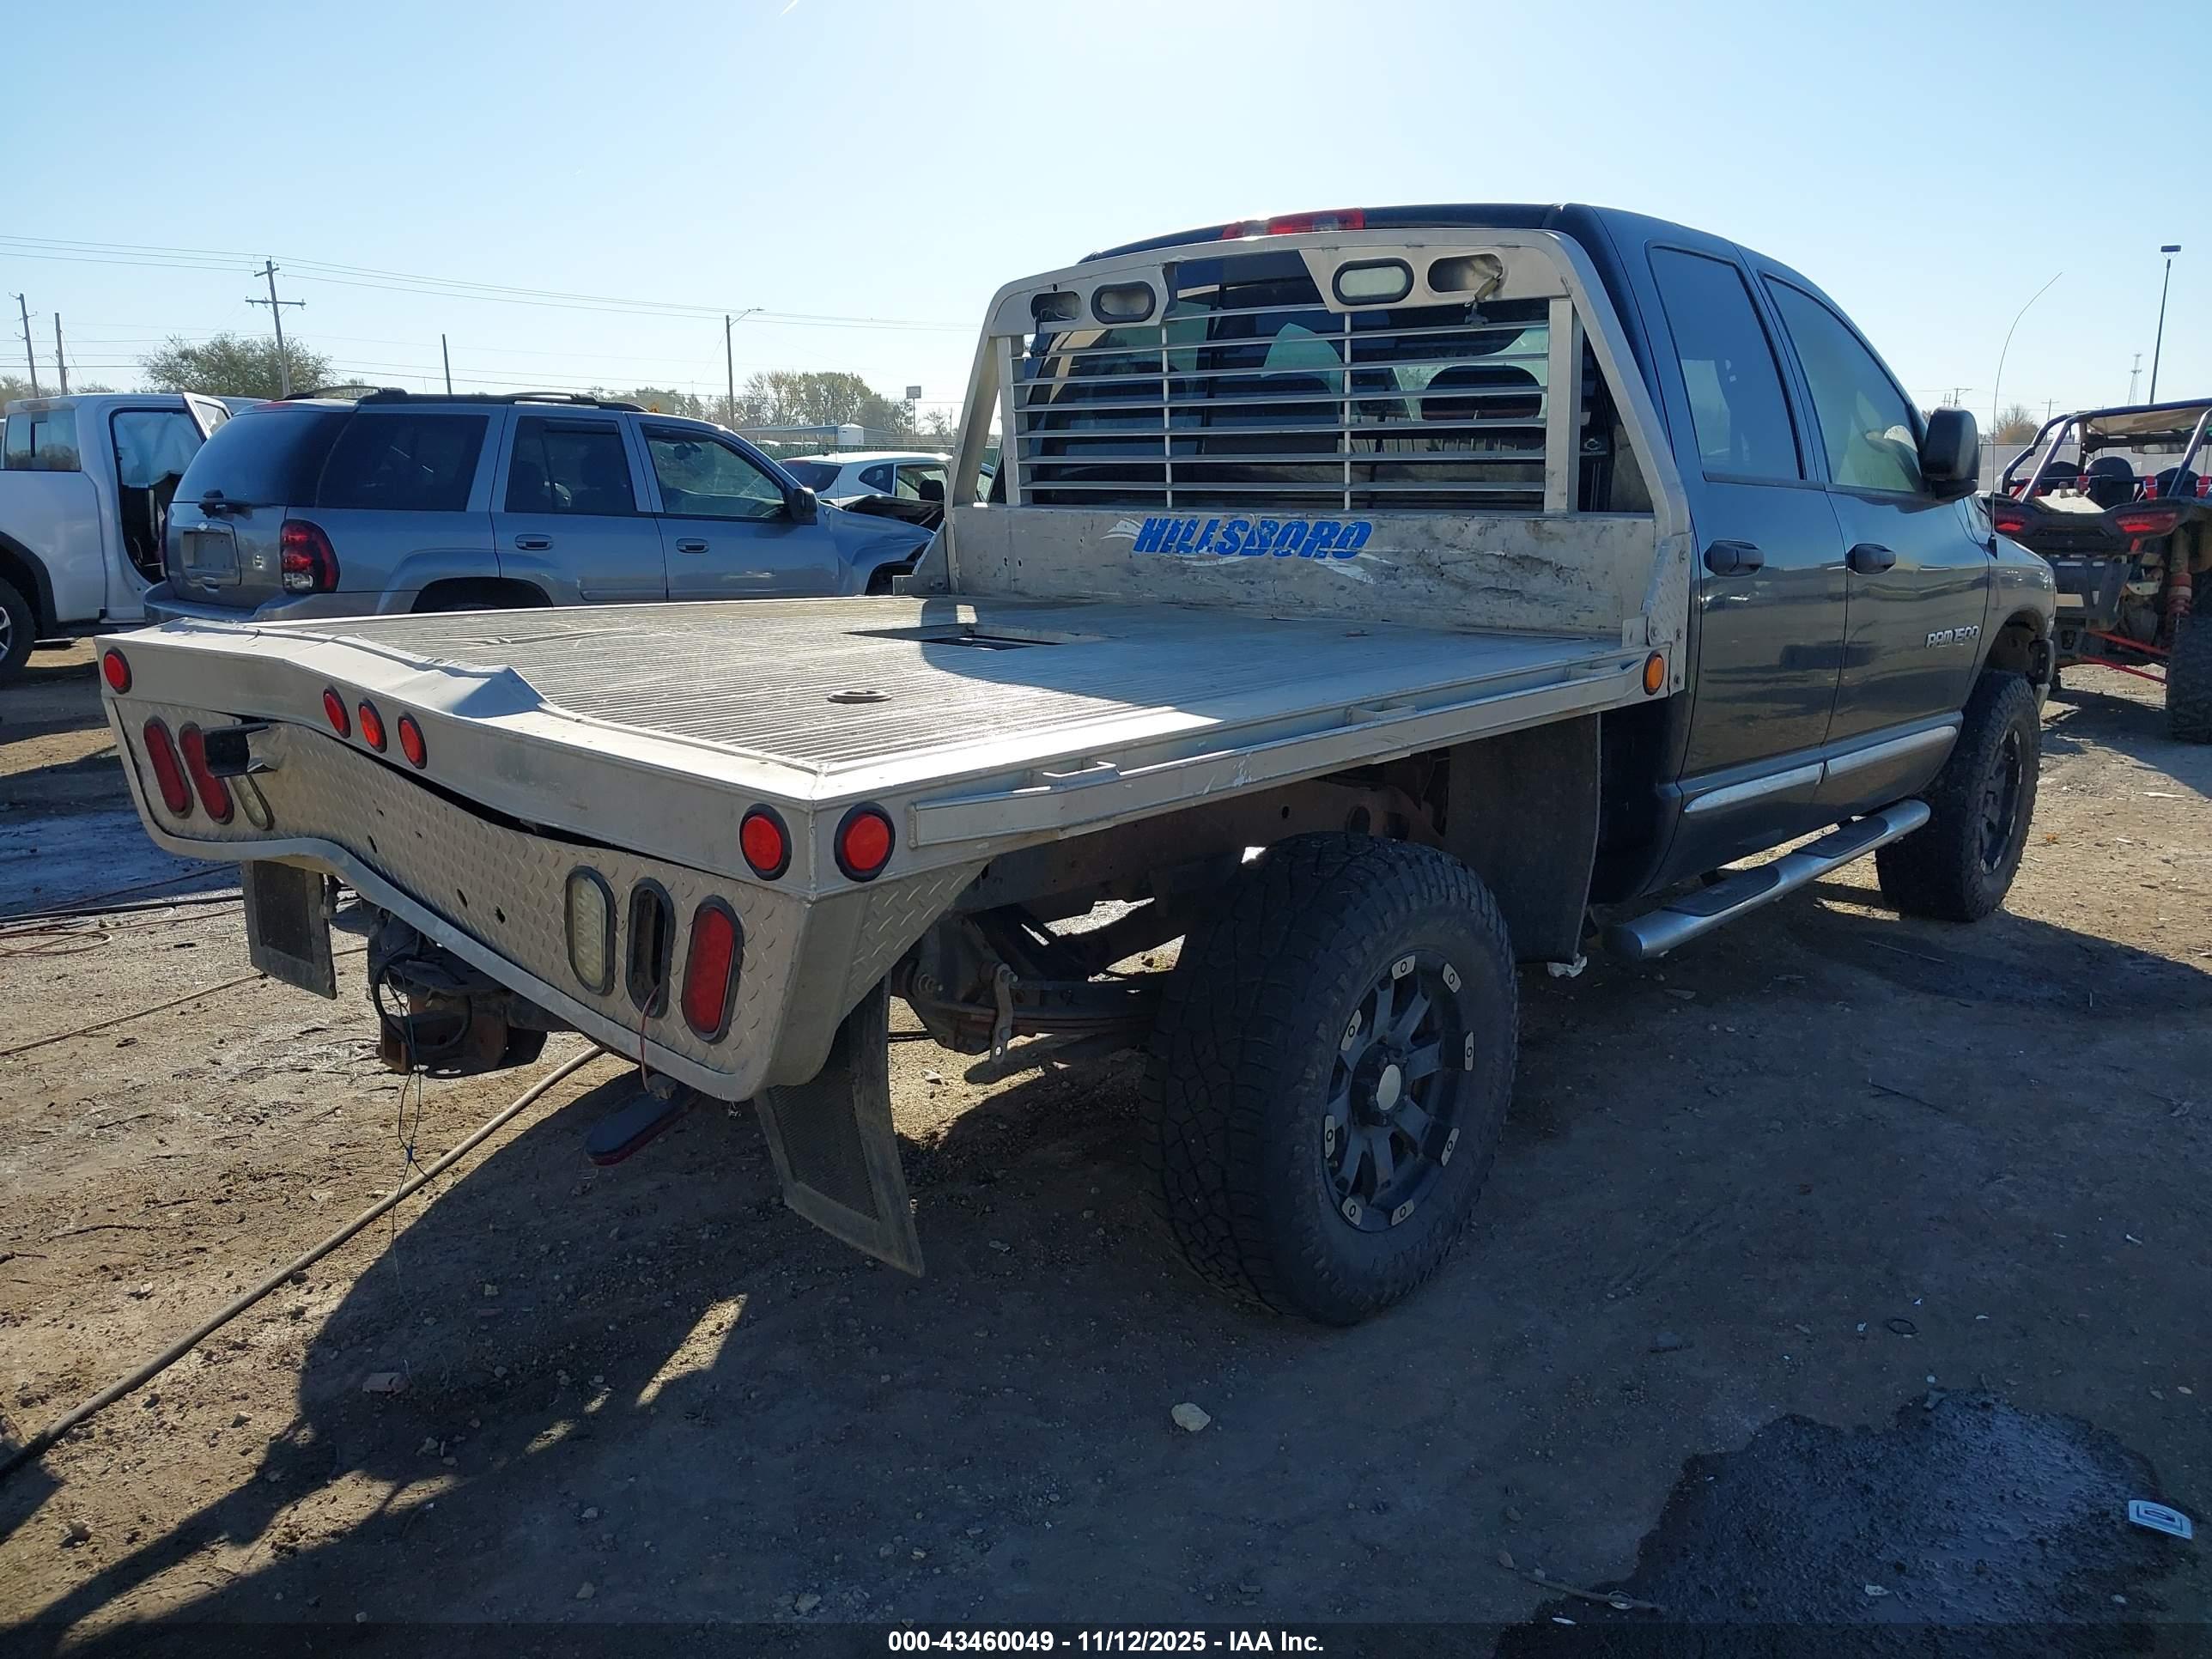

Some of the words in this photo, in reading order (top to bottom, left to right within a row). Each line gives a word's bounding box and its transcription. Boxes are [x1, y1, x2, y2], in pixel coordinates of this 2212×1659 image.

[1133, 517, 1373, 560] HILLSBORO
[1925, 629, 1953, 647] RAM
[1954, 625, 1979, 641] 1500
